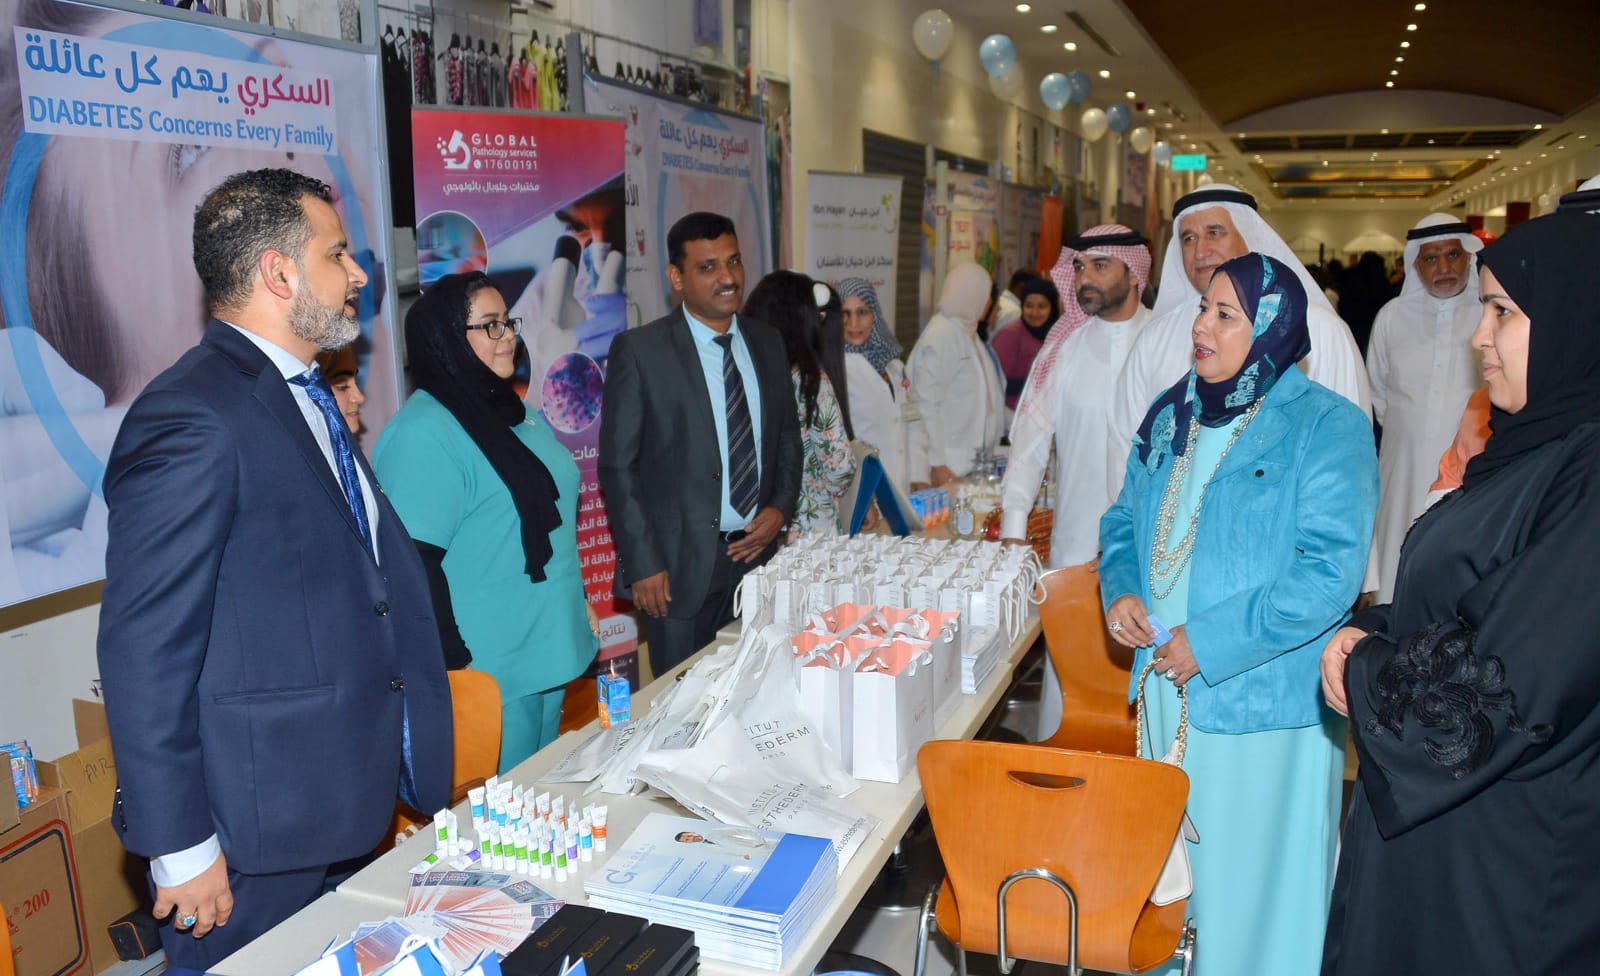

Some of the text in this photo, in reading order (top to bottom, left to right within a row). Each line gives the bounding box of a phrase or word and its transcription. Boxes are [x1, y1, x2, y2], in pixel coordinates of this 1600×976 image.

[25, 32, 330, 116] السكري يهم كل عائلة
[28, 95, 334, 153] DIABETES Concerns Every Family
[471, 132, 537, 147] GLOBAL
[472, 146, 537, 159] Pathology services
[484, 159, 537, 170] 17600191
[23, 888, 51, 920] 200
